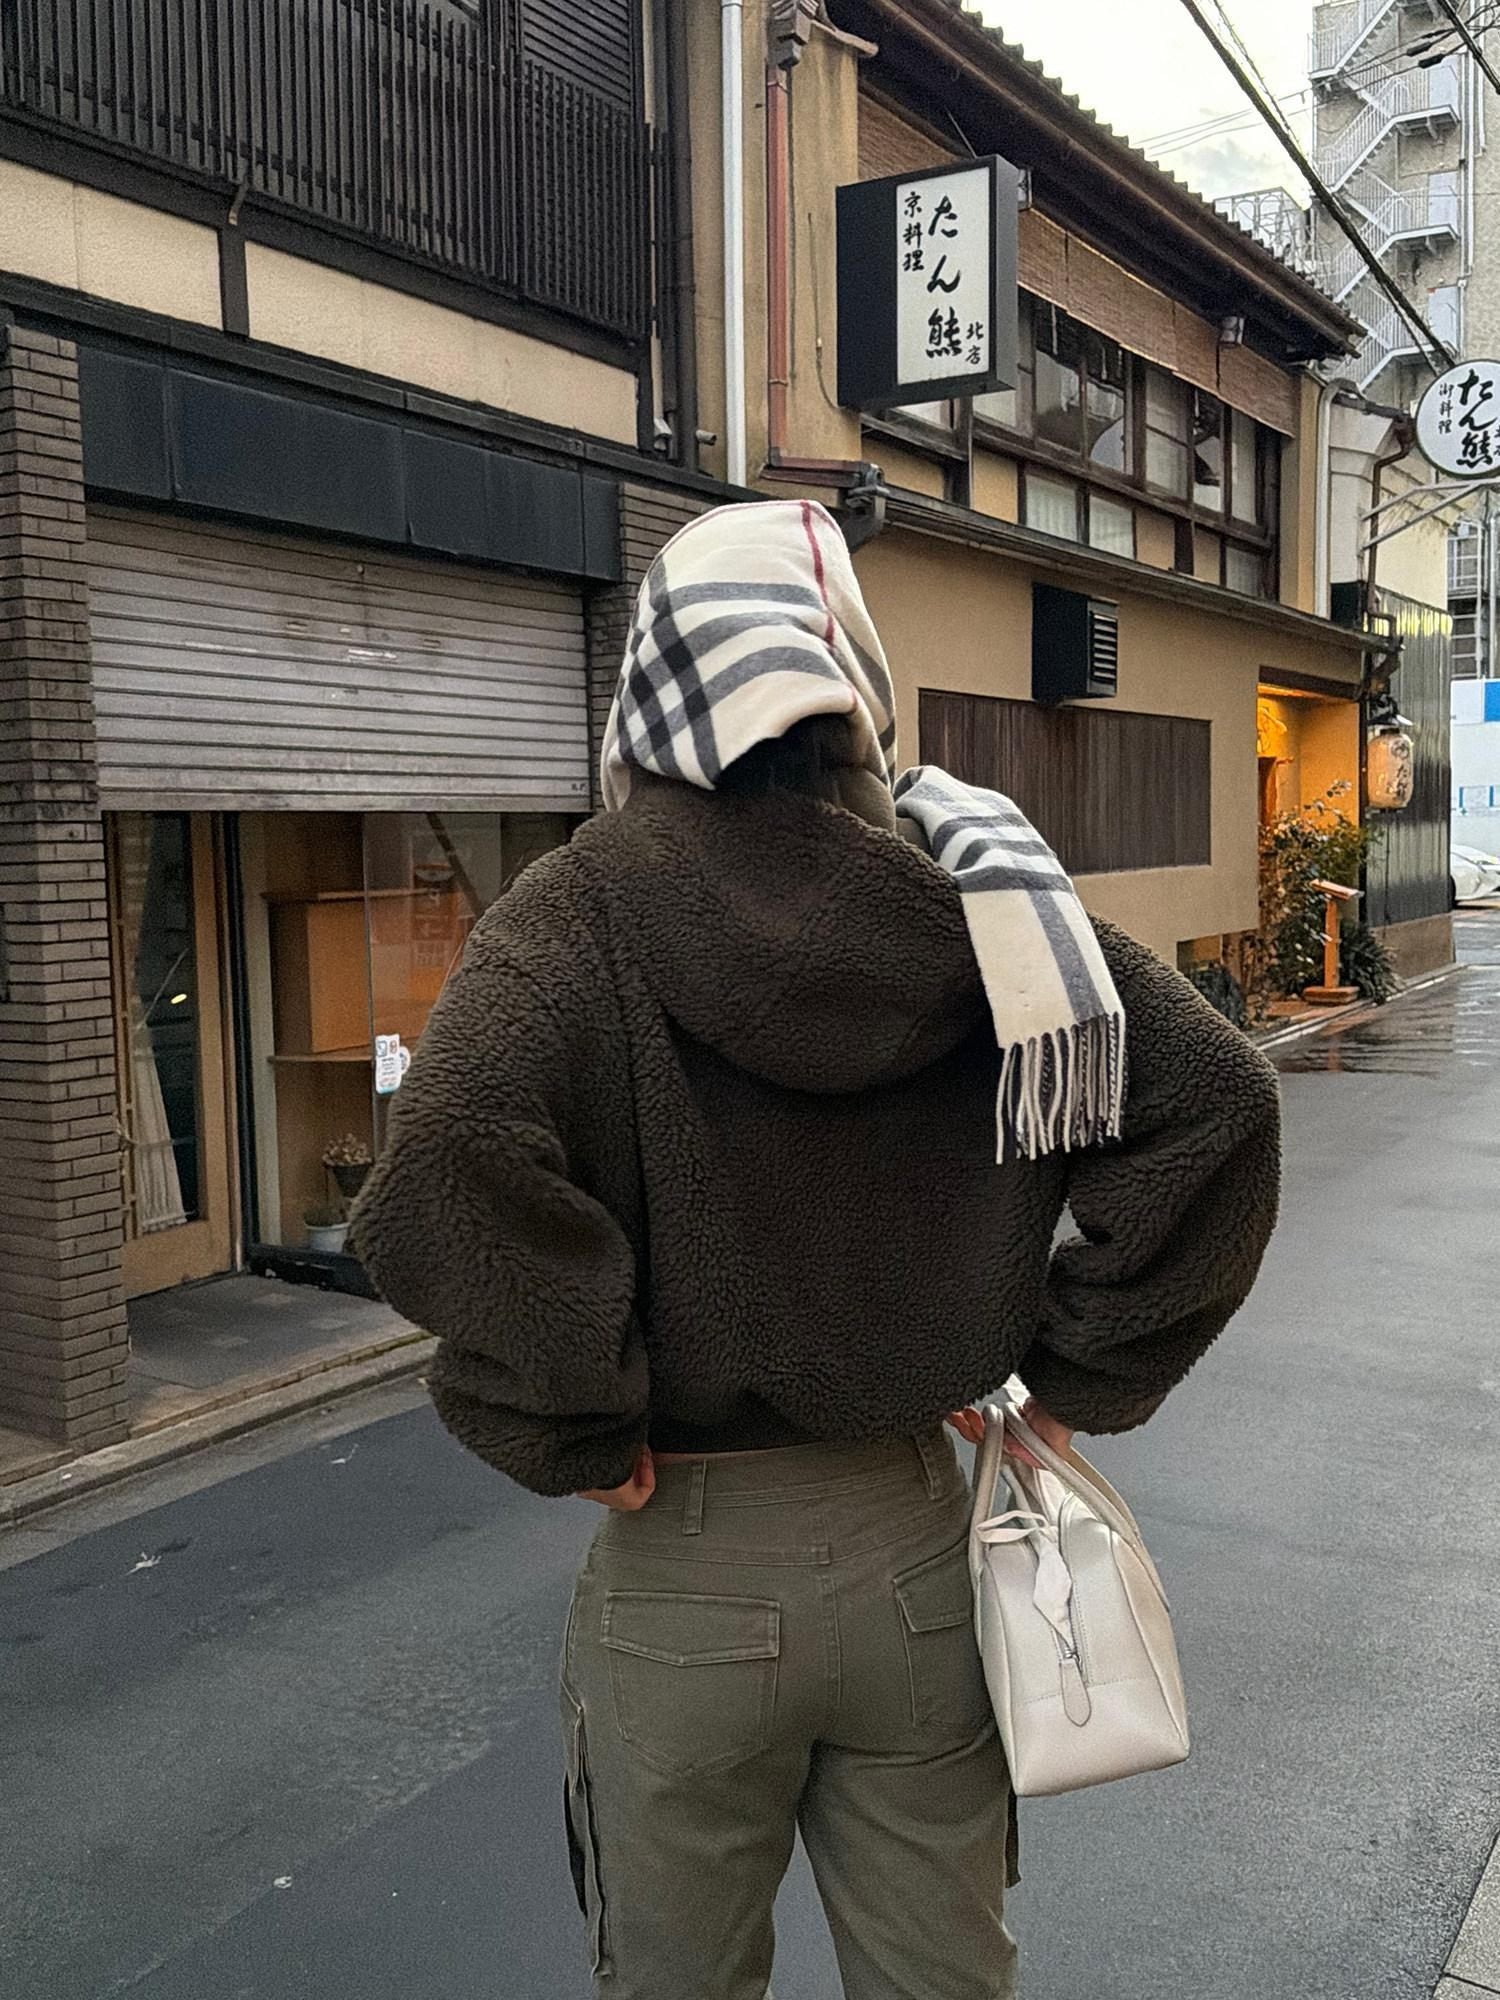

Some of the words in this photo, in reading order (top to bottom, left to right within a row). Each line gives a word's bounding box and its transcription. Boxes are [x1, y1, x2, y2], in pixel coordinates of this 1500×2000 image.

[902, 191, 925, 272] 京料理
[926, 195, 963, 359] たん熊
[1456, 367, 1498, 470] たん熊
